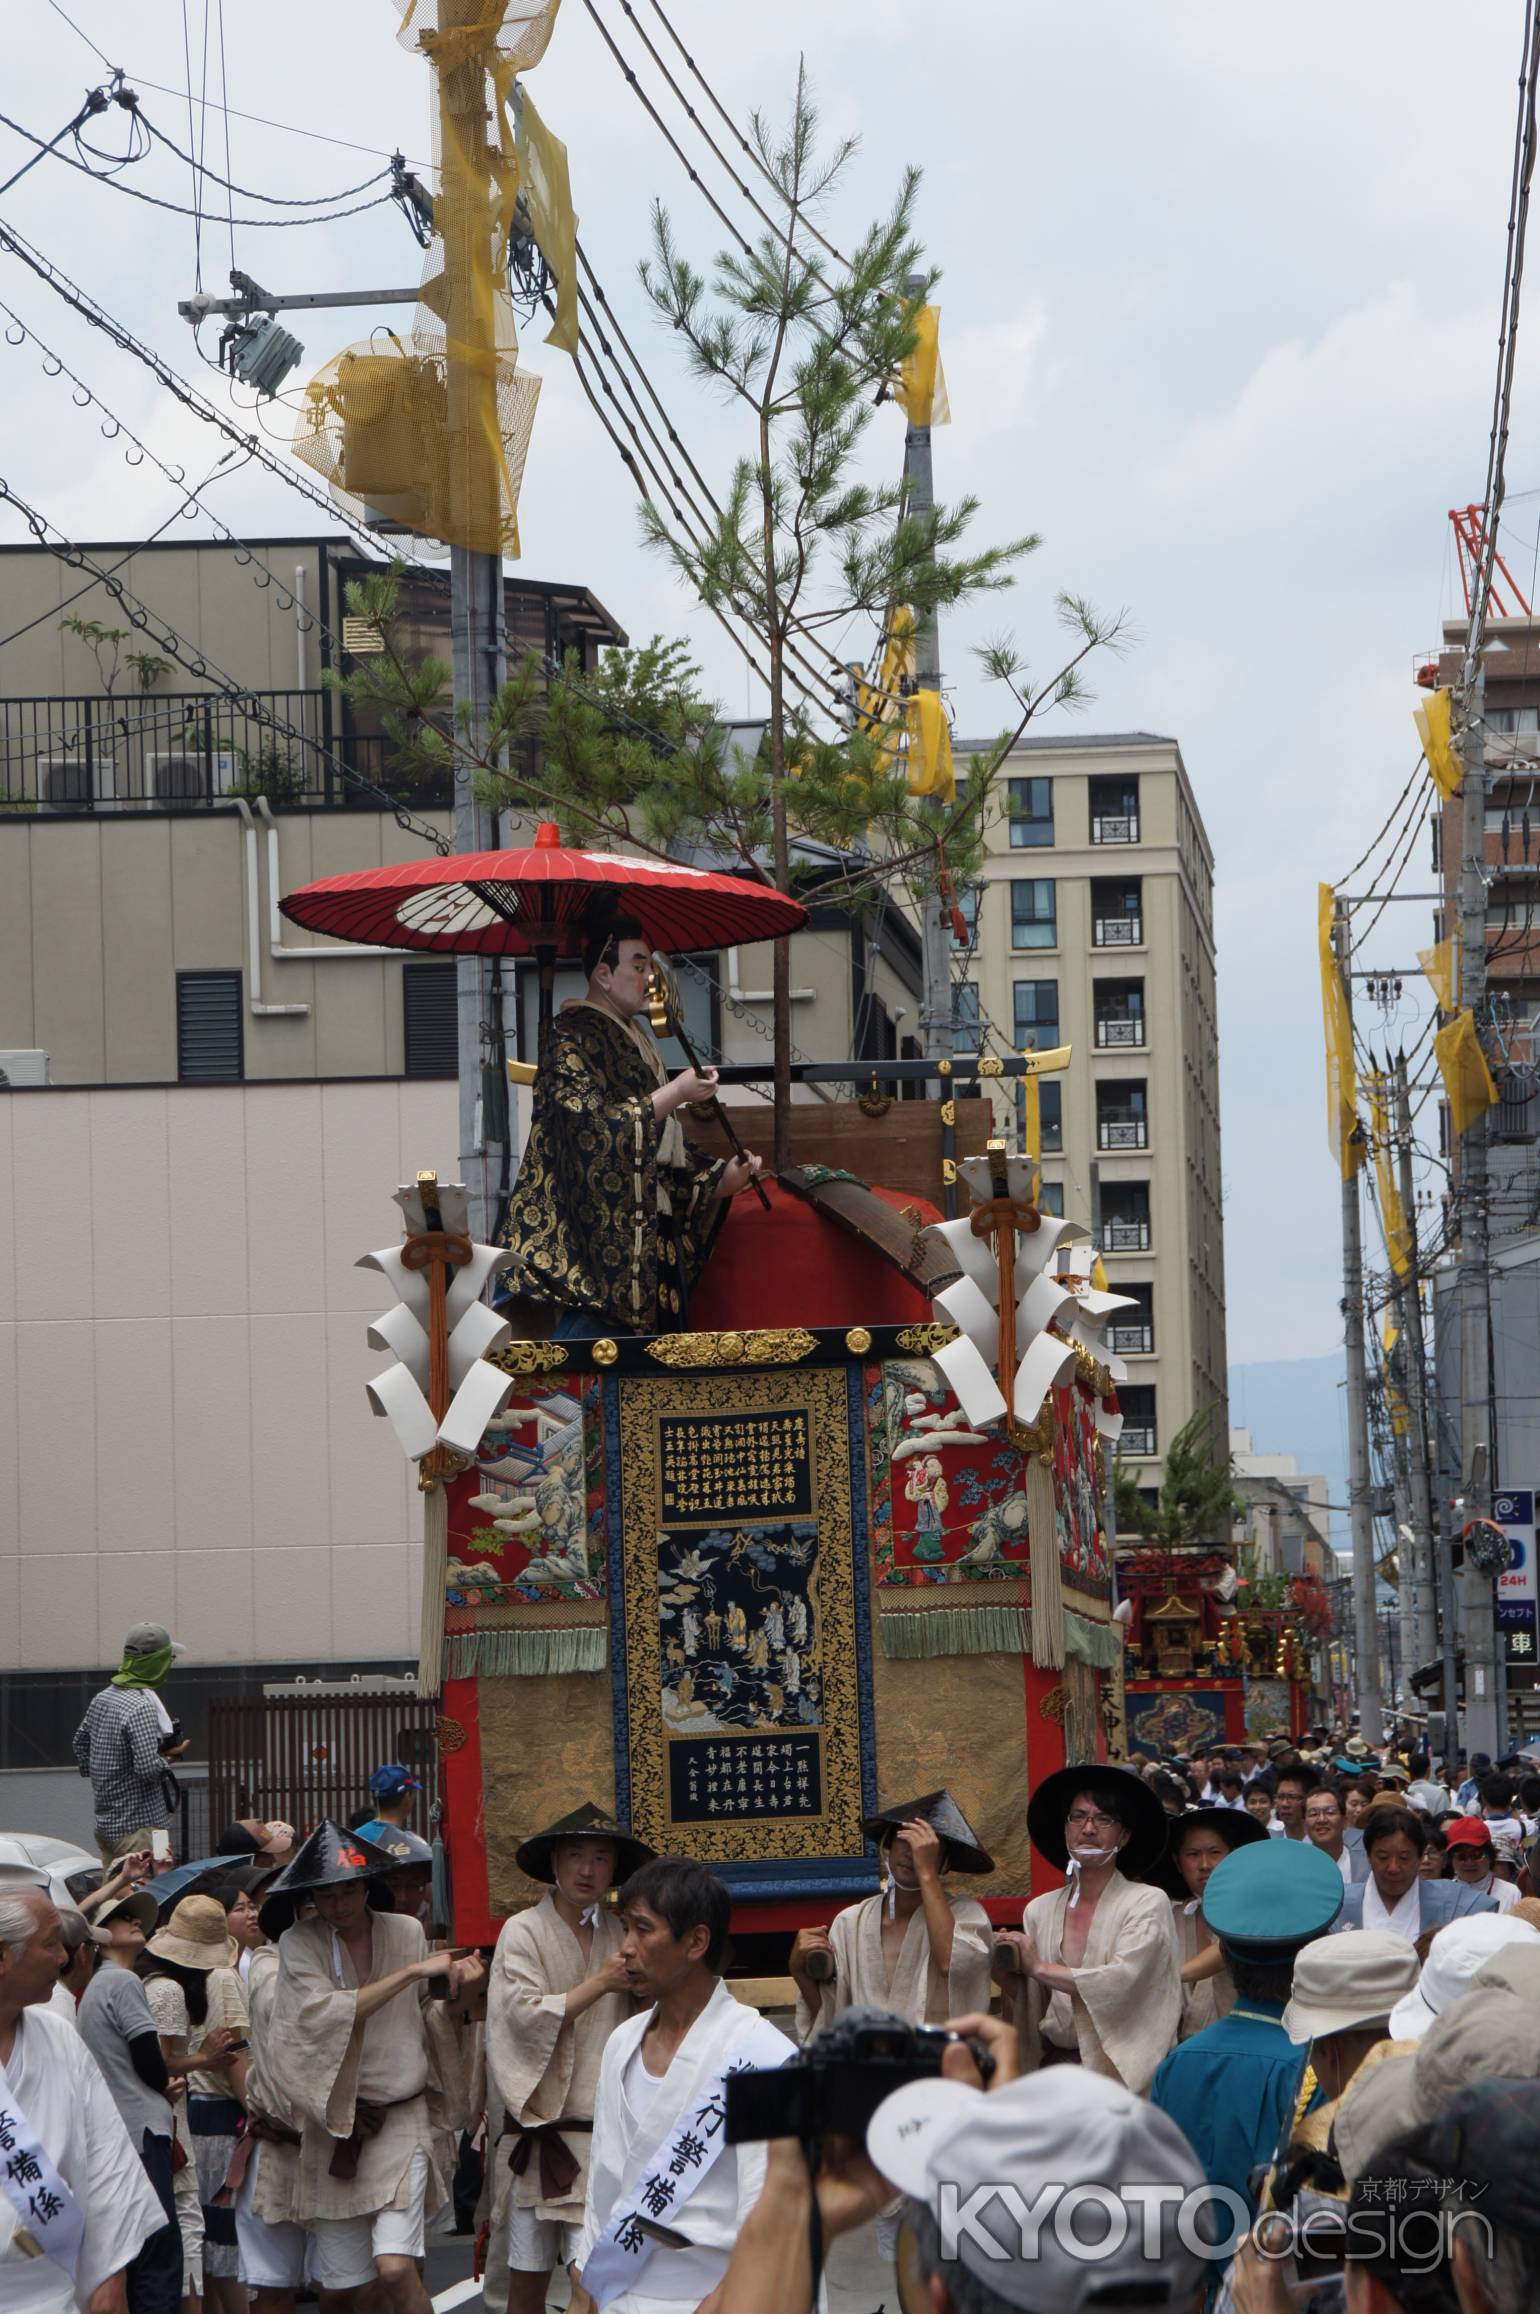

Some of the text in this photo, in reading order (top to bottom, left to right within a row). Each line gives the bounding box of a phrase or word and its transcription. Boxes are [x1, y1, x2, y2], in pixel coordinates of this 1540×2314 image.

[1500, 1575, 1527, 1586] 24H
[336, 1845, 367, 1869] 伯
[613, 2057, 758, 2254] 行警備係
